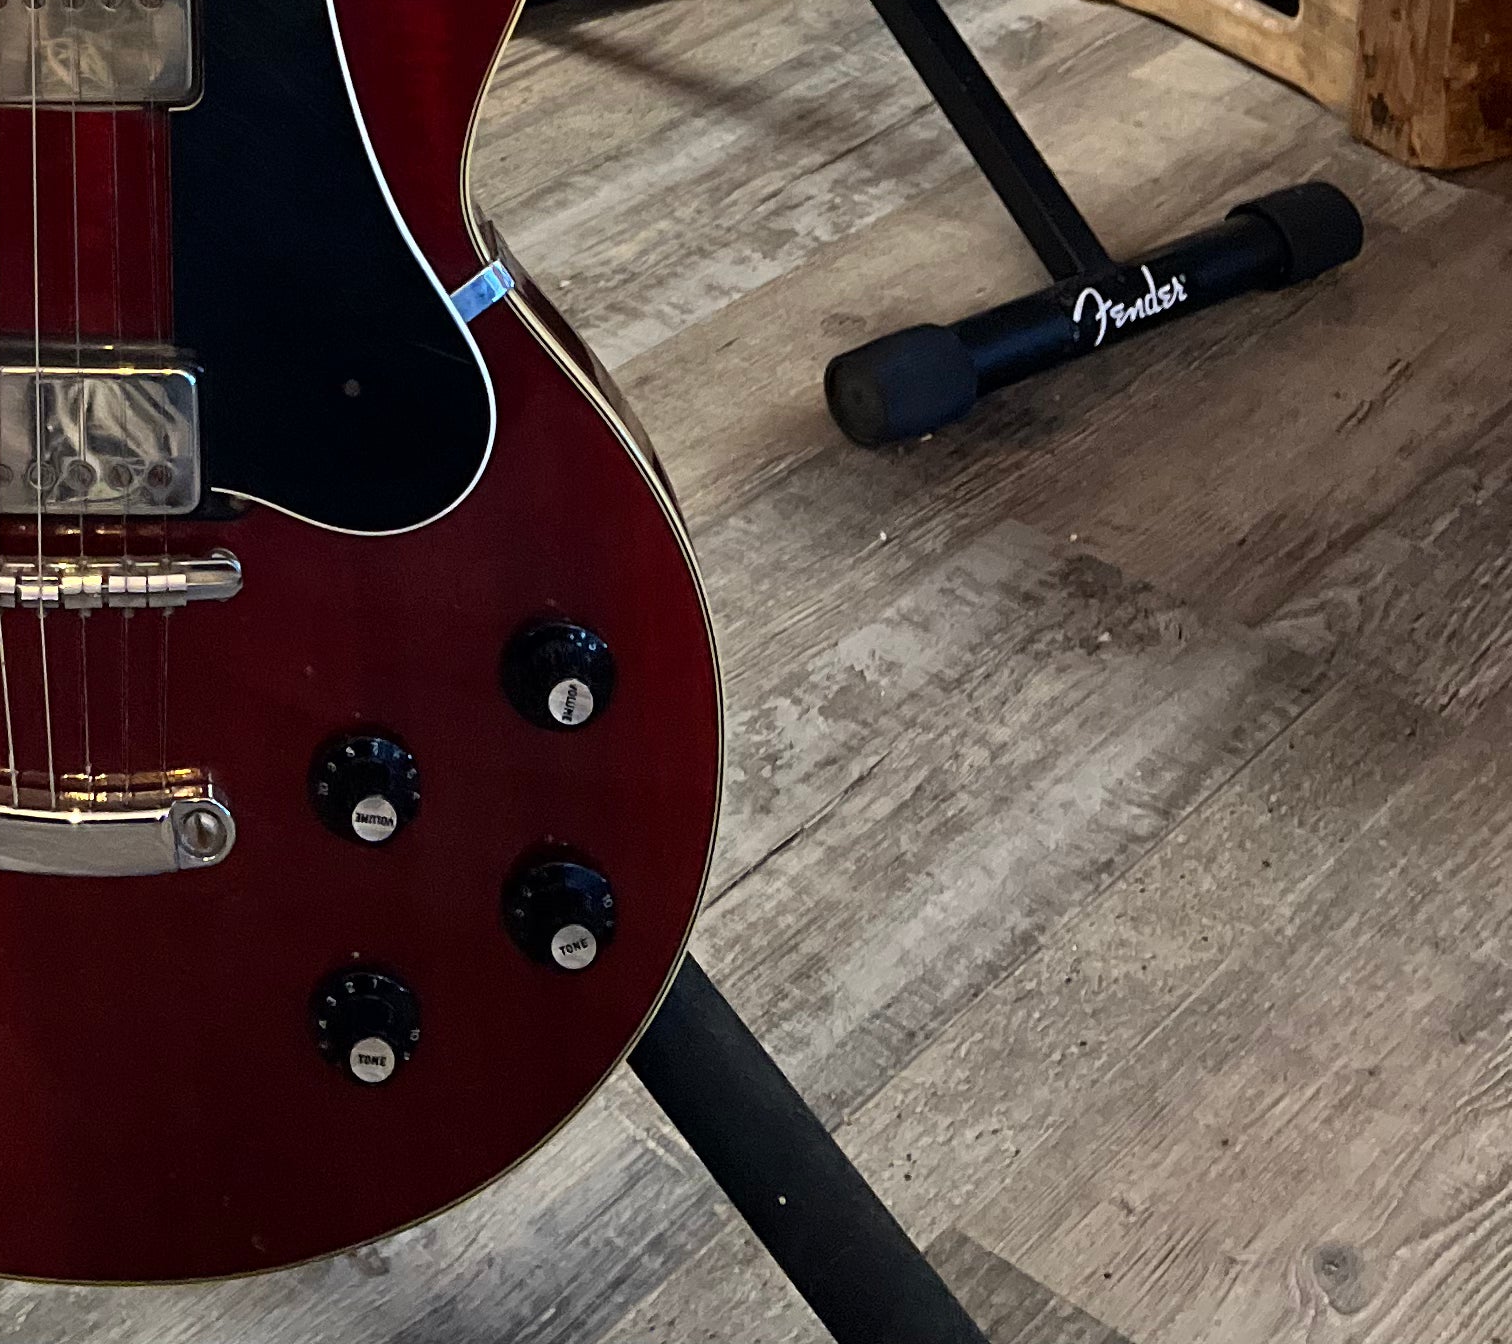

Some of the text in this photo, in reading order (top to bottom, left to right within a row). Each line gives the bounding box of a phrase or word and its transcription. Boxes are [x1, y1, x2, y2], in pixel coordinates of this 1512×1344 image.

[1072, 264, 1188, 347] Fender
[558, 937, 589, 956] TONE
[358, 1053, 387, 1067] TONE
